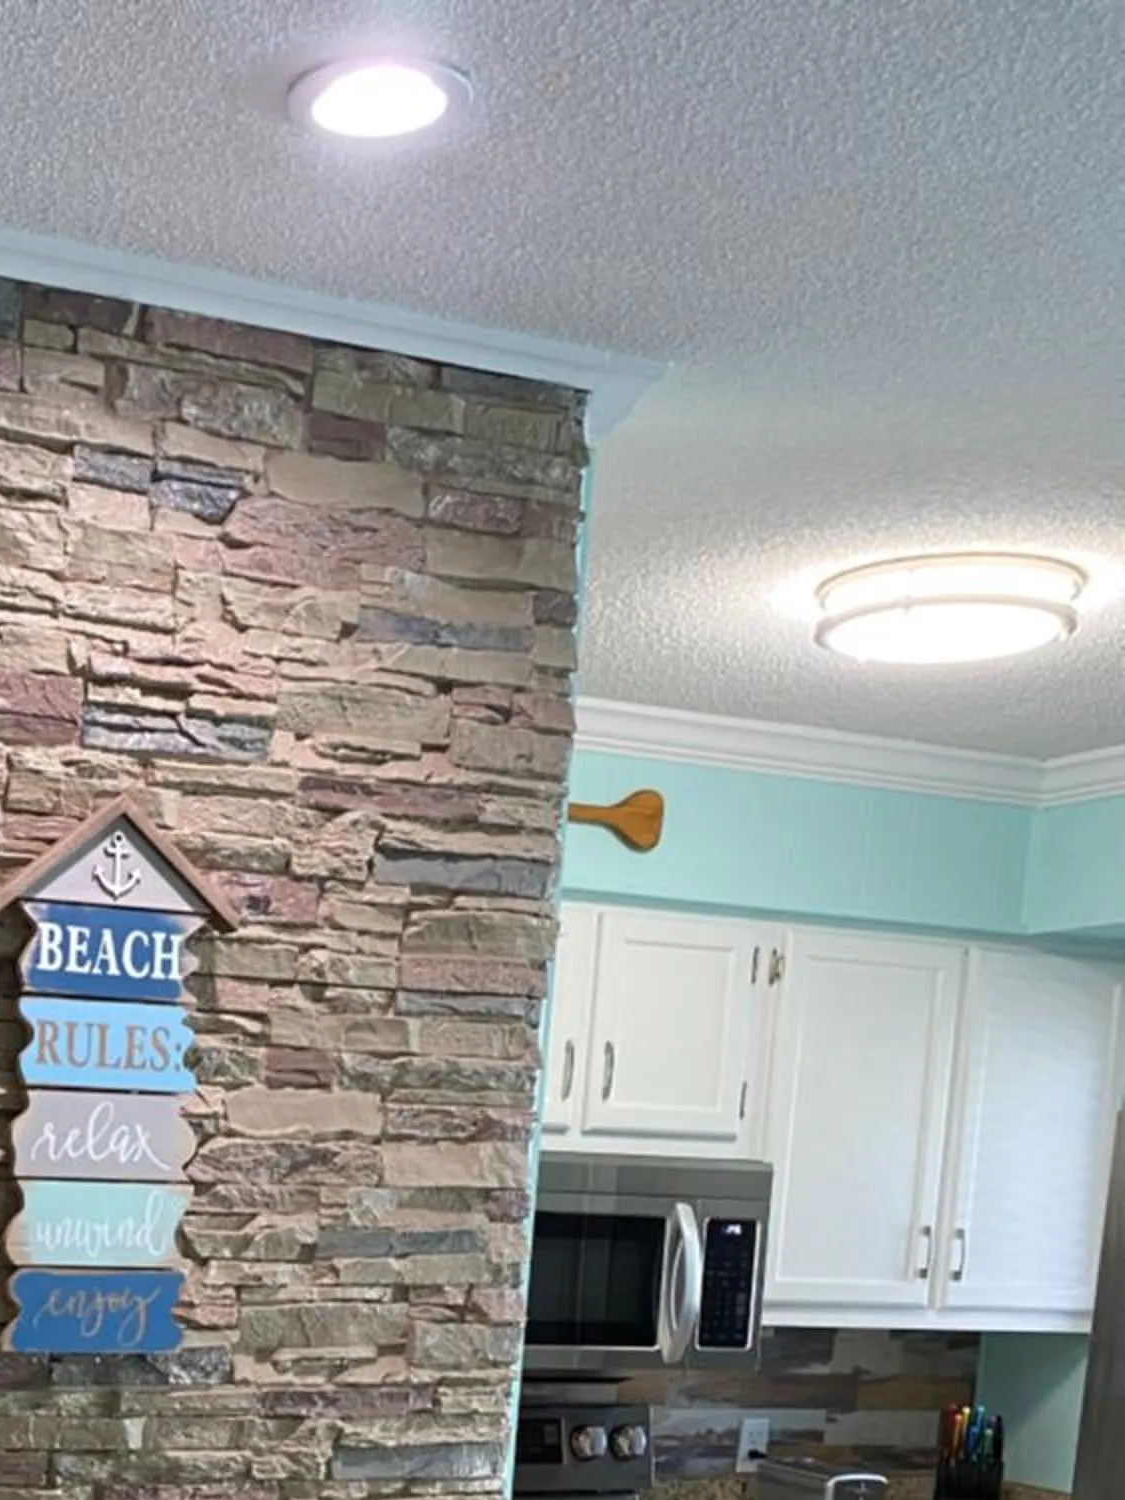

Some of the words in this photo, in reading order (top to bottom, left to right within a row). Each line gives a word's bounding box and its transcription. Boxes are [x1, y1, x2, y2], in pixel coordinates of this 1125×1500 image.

[35, 921, 184, 980] BEACH
[34, 1018, 182, 1073] RULES:
[30, 1101, 172, 1171] relax
[35, 1187, 168, 1258] unwind
[32, 1285, 163, 1347] enjoy
